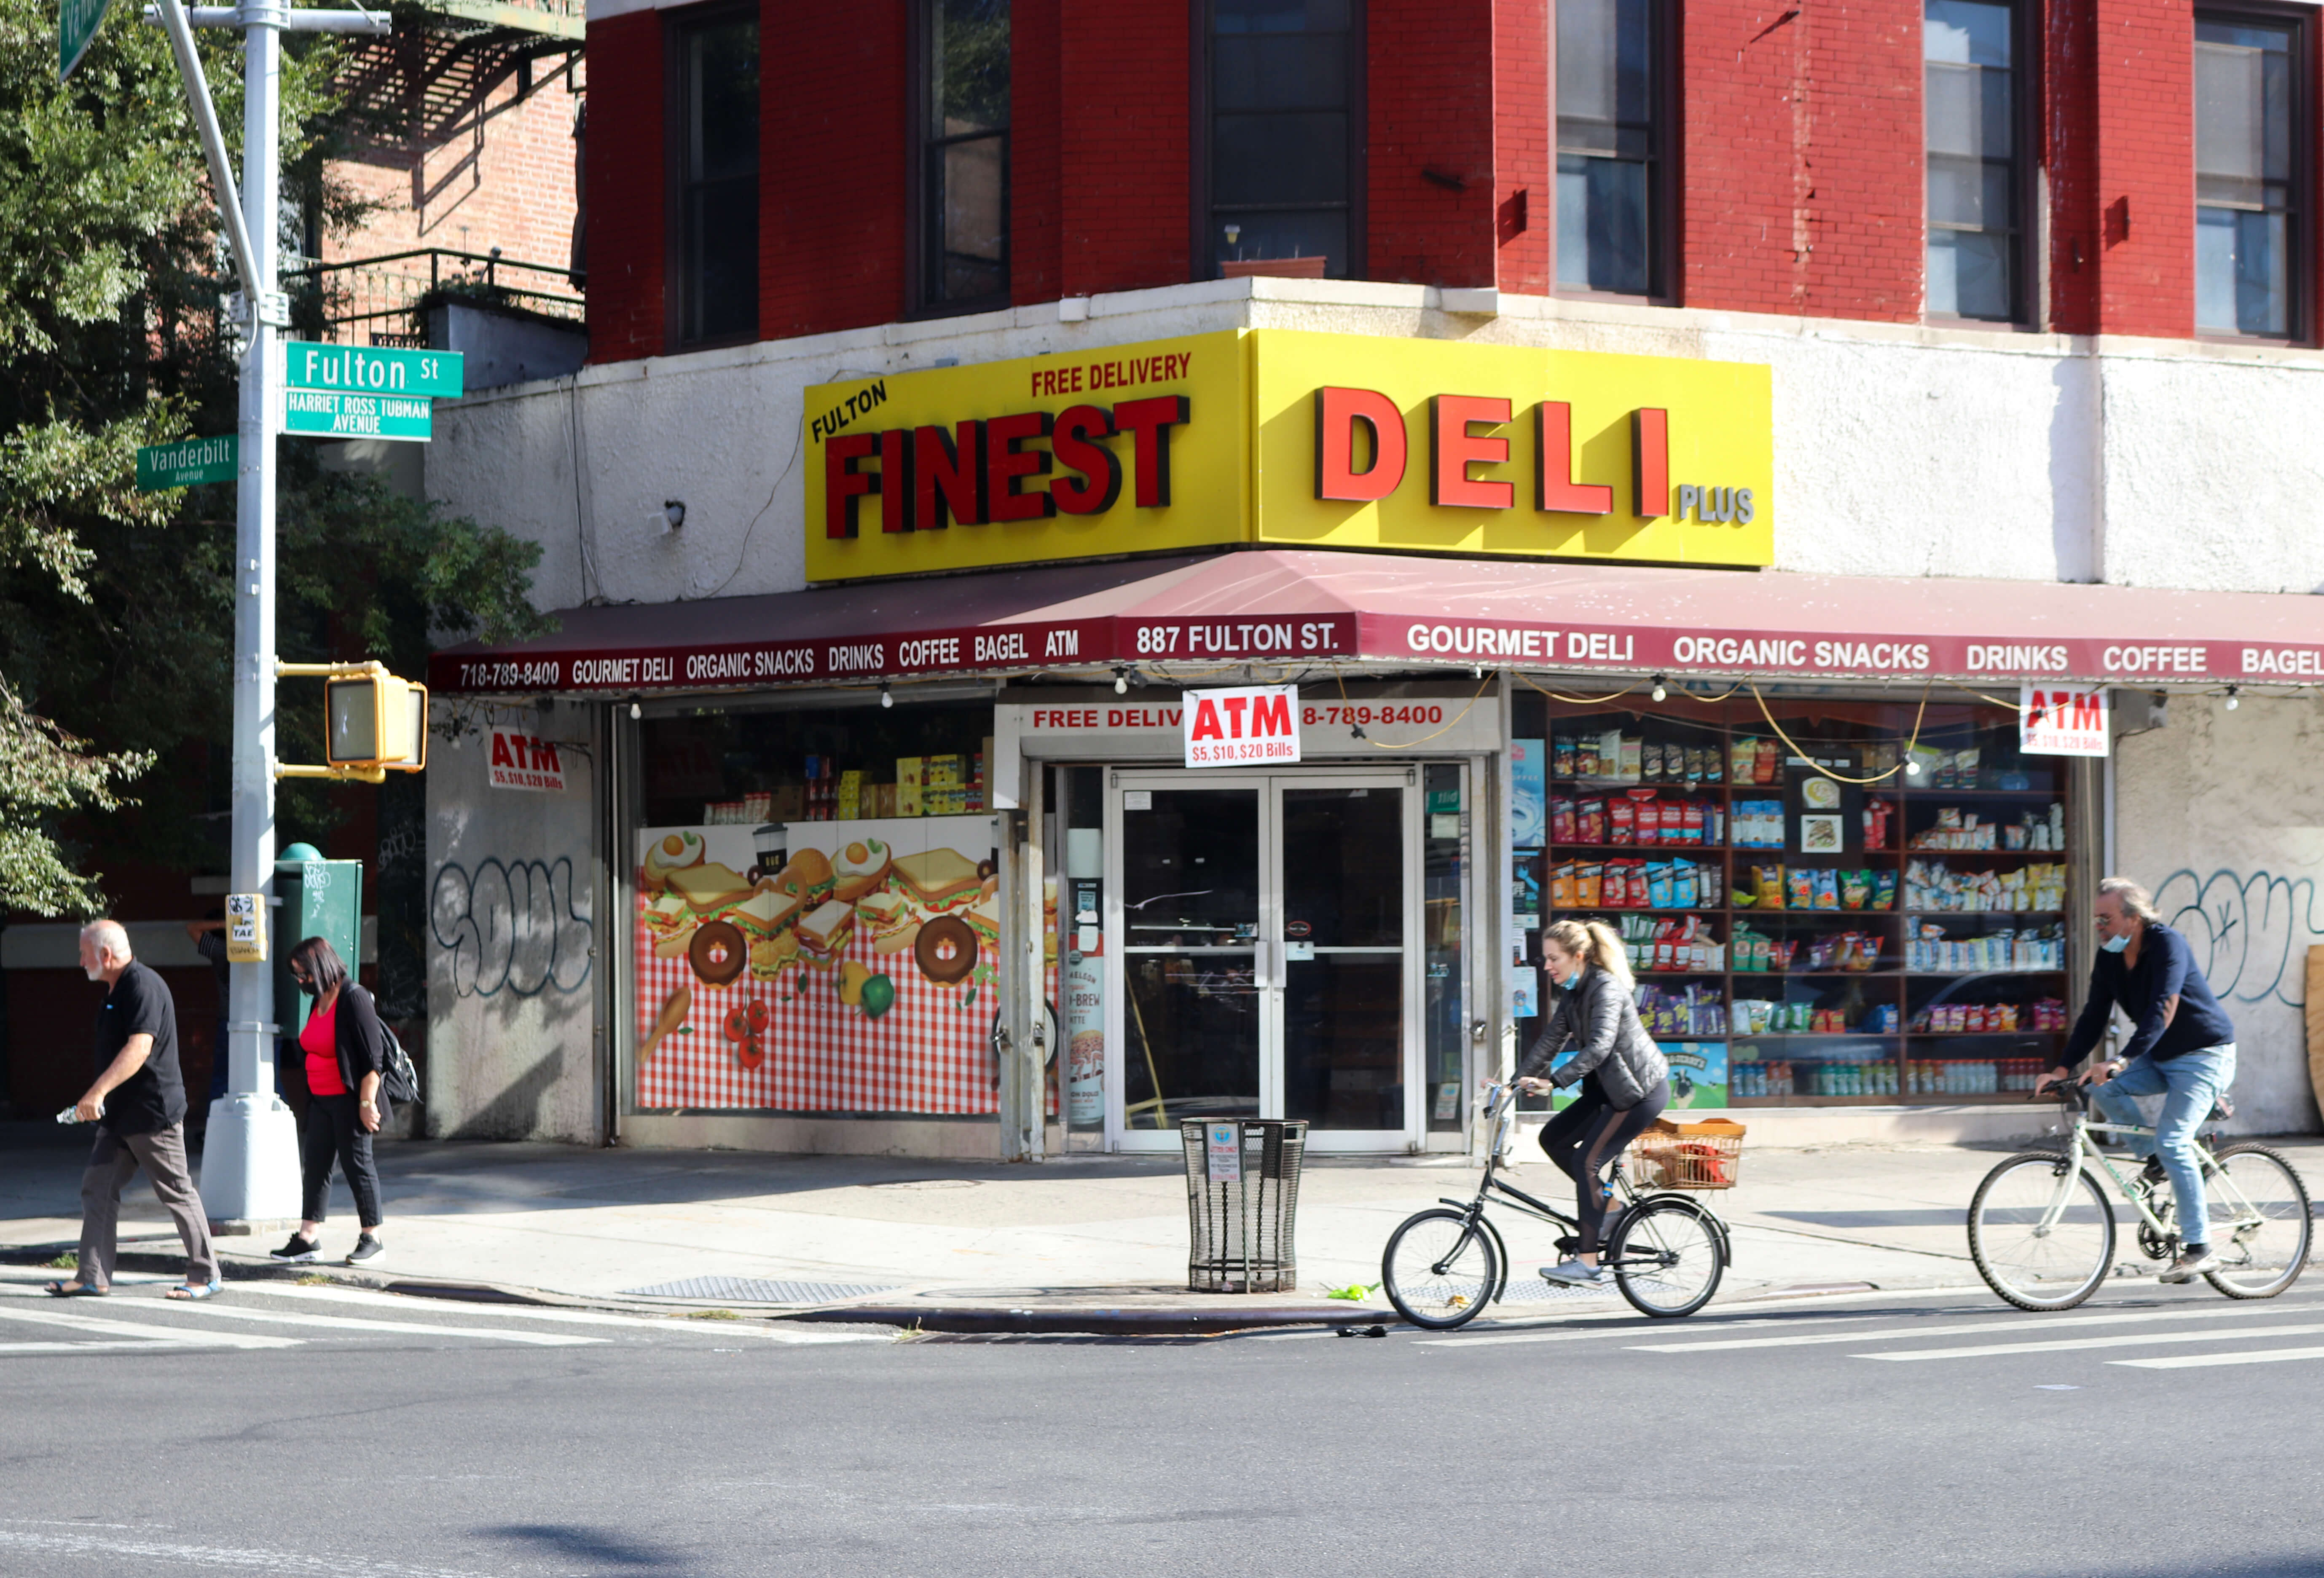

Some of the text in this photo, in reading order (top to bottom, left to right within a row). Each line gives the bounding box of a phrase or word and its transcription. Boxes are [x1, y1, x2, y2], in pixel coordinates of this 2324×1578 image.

[306, 350, 438, 389] Fulton St
[1032, 353, 1192, 397] FREE DELIVERY
[289, 394, 429, 419] HARRIET ROSS TUBMAN
[811, 380, 888, 443] FULTON
[333, 414, 381, 434] AVENUE
[151, 439, 229, 472] Vanderbilt
[1315, 386, 1669, 517] DELI
[175, 469, 204, 482] Avenue
[826, 395, 1191, 539] FINEST
[1680, 485, 1754, 524] PLUS
[975, 632, 1028, 662] BAGEL
[1045, 630, 1078, 656] ATM
[1137, 622, 1338, 653] 887 FULTON ST.
[1407, 624, 1634, 660] GOURMET DELI
[687, 648, 814, 679] ORGANIC SNACKS
[829, 644, 883, 671] DRINKS
[899, 638, 959, 666] COFFEE
[1673, 636, 1930, 670] ORGANIC SNACKS
[1967, 644, 2068, 671] DRINKS
[2103, 646, 2207, 673] COFFEE
[2242, 648, 2324, 675] BAGEL
[460, 662, 559, 687] 718-789-8400
[572, 657, 673, 683] GOURMET DELI
[1033, 708, 1183, 728] FREE DELIV
[1191, 694, 1292, 741] ATM
[1303, 706, 1443, 726] 8-789-8400
[2026, 690, 2102, 731] ATM
[492, 732, 561, 772] ATM
[1240, 743, 1262, 758] $20
[1267, 742, 1293, 757] Bills
[526, 774, 543, 787] $20
[545, 776, 563, 789] Bills
[1070, 1016, 1085, 1024] ATTE
